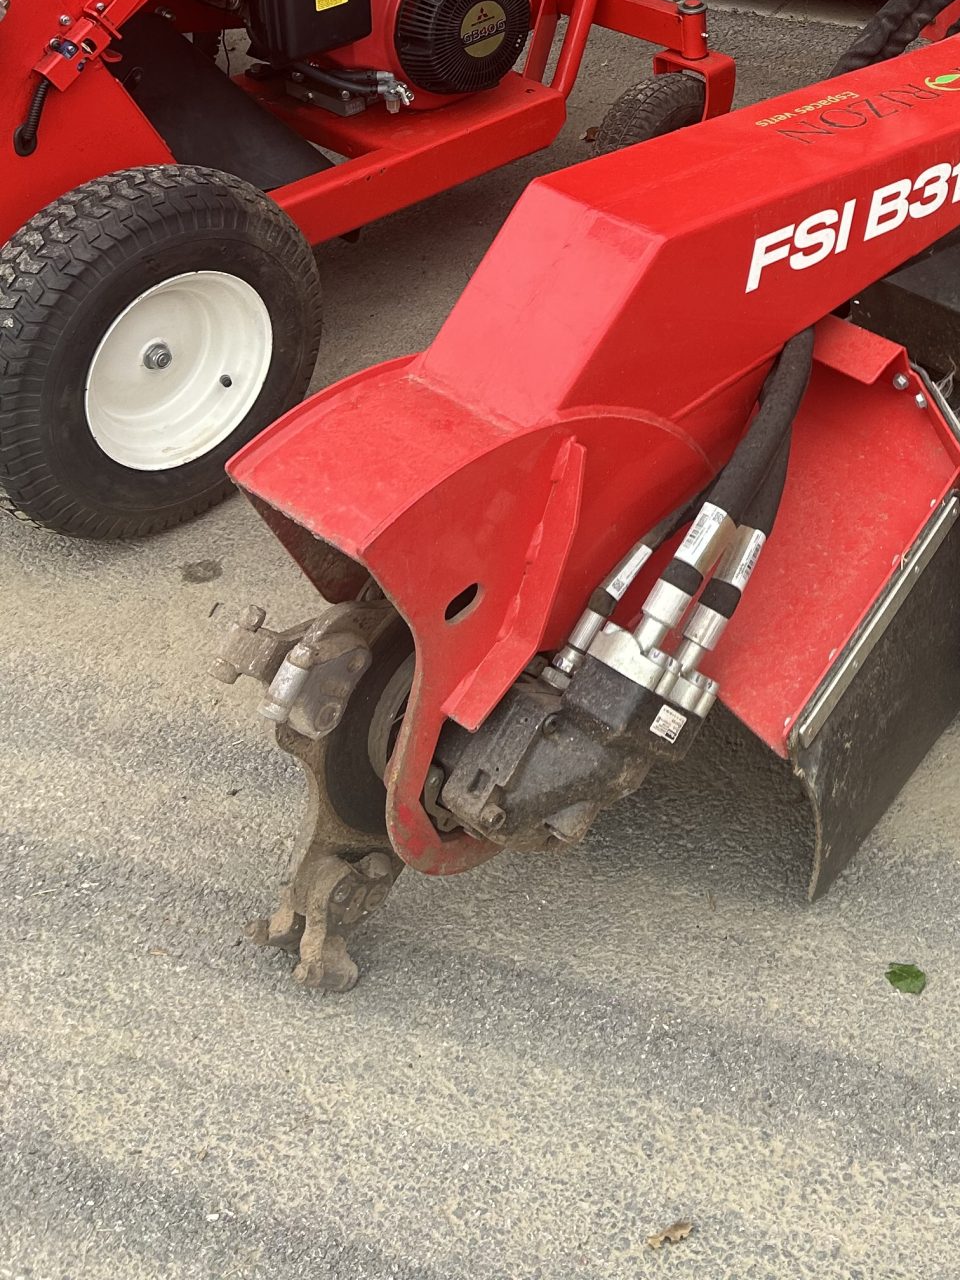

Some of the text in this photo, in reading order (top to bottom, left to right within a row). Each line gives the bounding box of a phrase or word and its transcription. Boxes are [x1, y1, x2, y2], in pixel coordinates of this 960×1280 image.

[755, 90, 860, 128] Espaces verts
[745, 198, 857, 294] FSI
